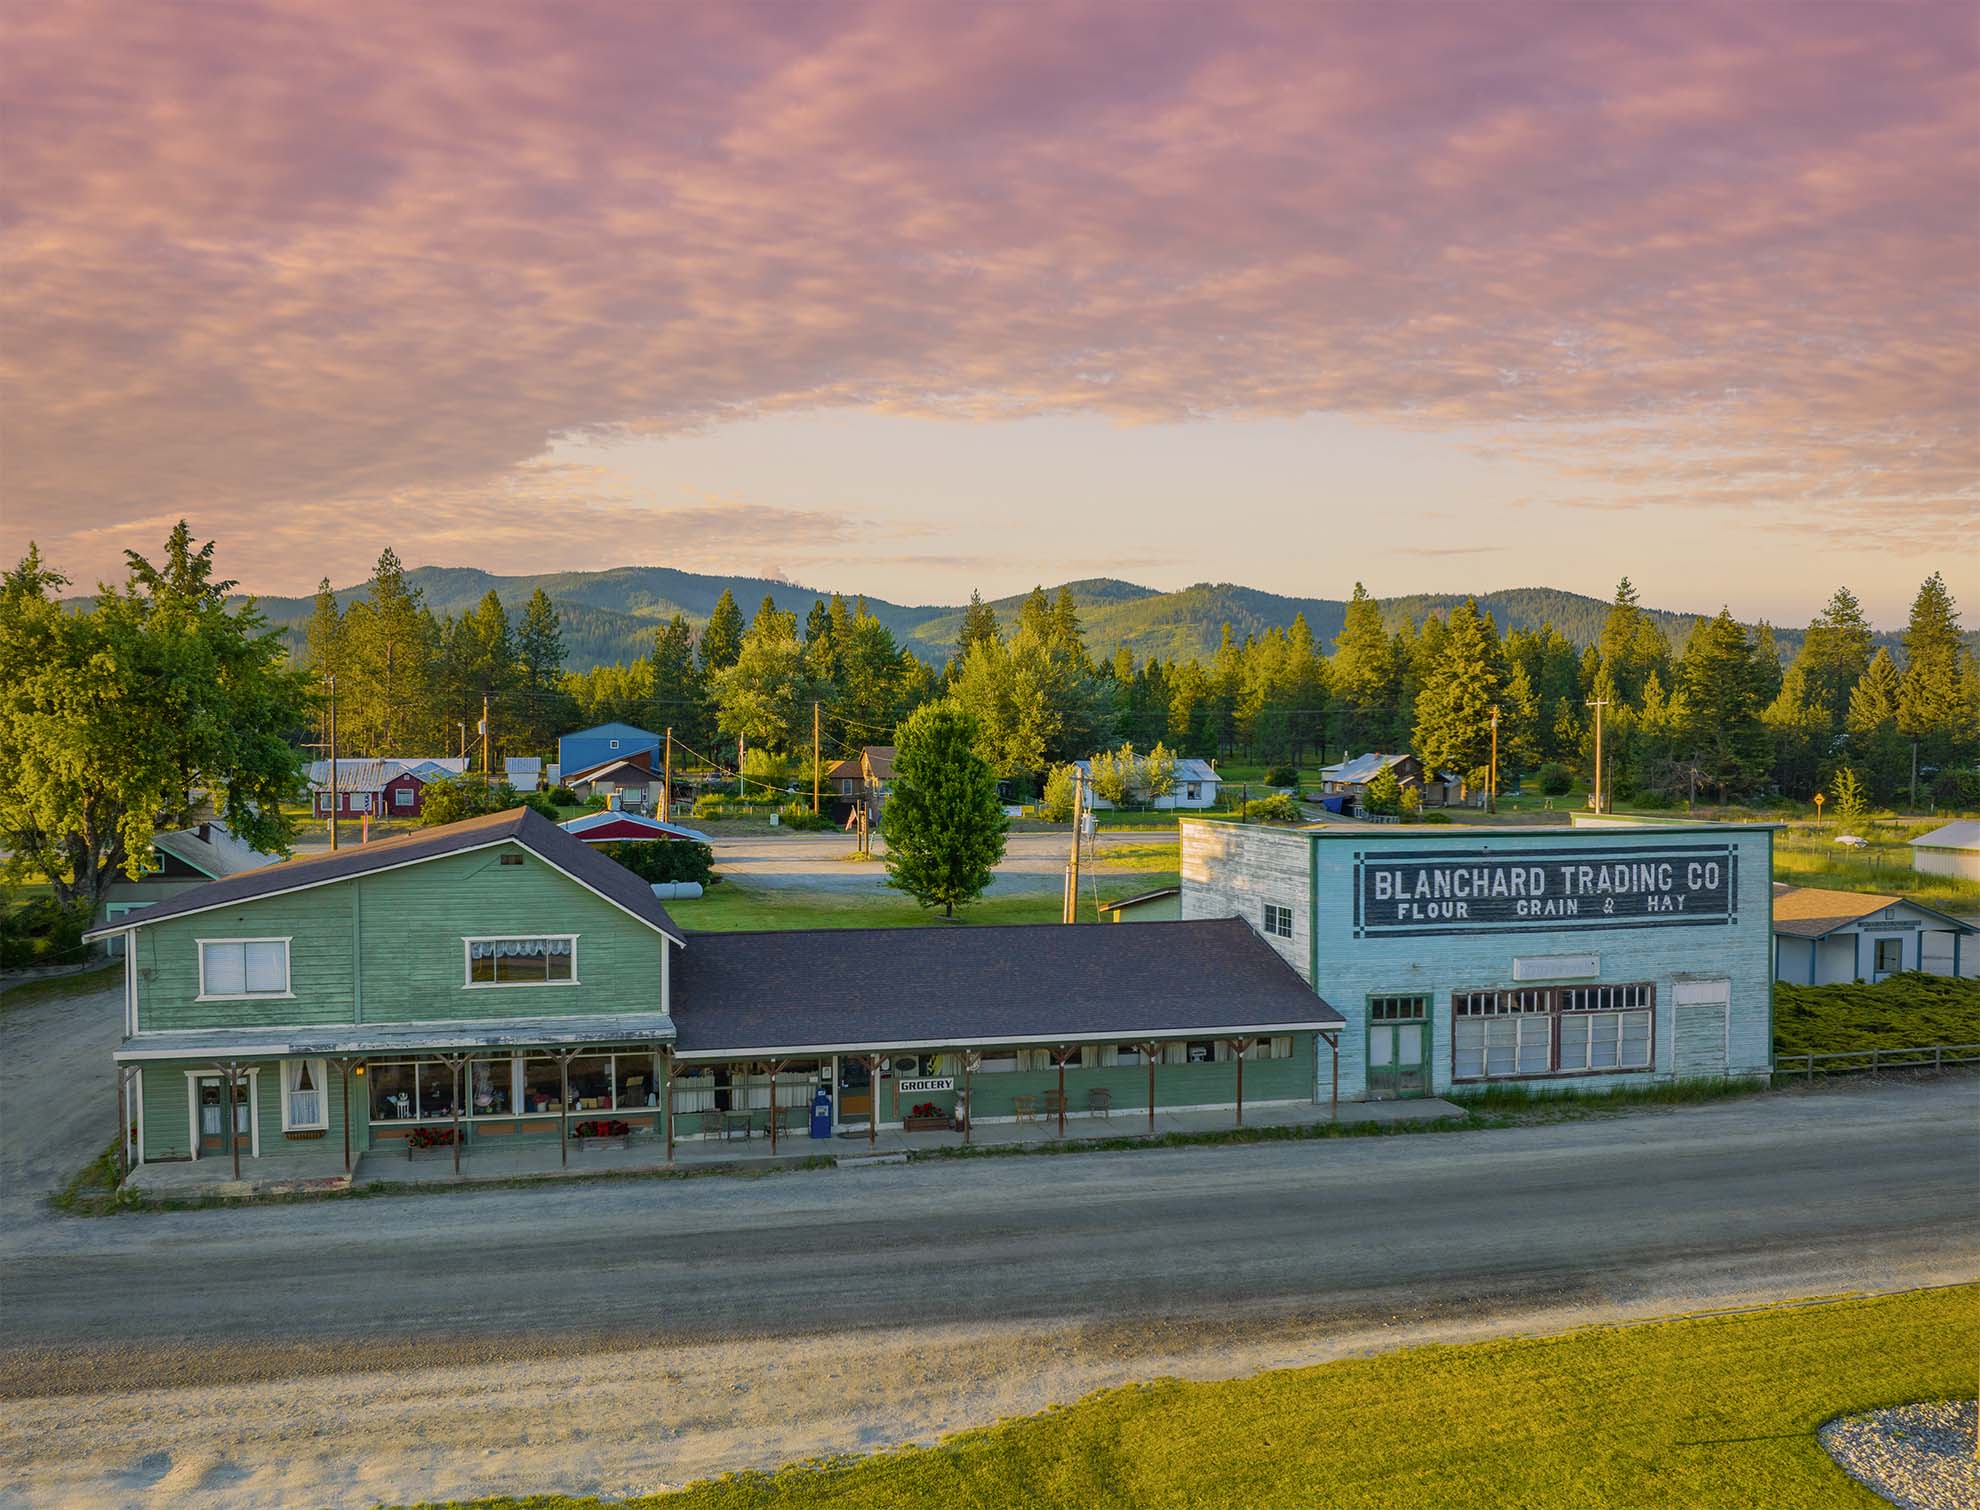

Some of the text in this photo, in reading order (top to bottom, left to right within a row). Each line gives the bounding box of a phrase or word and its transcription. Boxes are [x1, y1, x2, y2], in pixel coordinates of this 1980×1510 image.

[1375, 862, 1719, 900] BLANCHARD TRADING CO
[1397, 894, 1686, 920] FLOUR GRAIN & HAY
[901, 1079, 952, 1091] GROCERY
